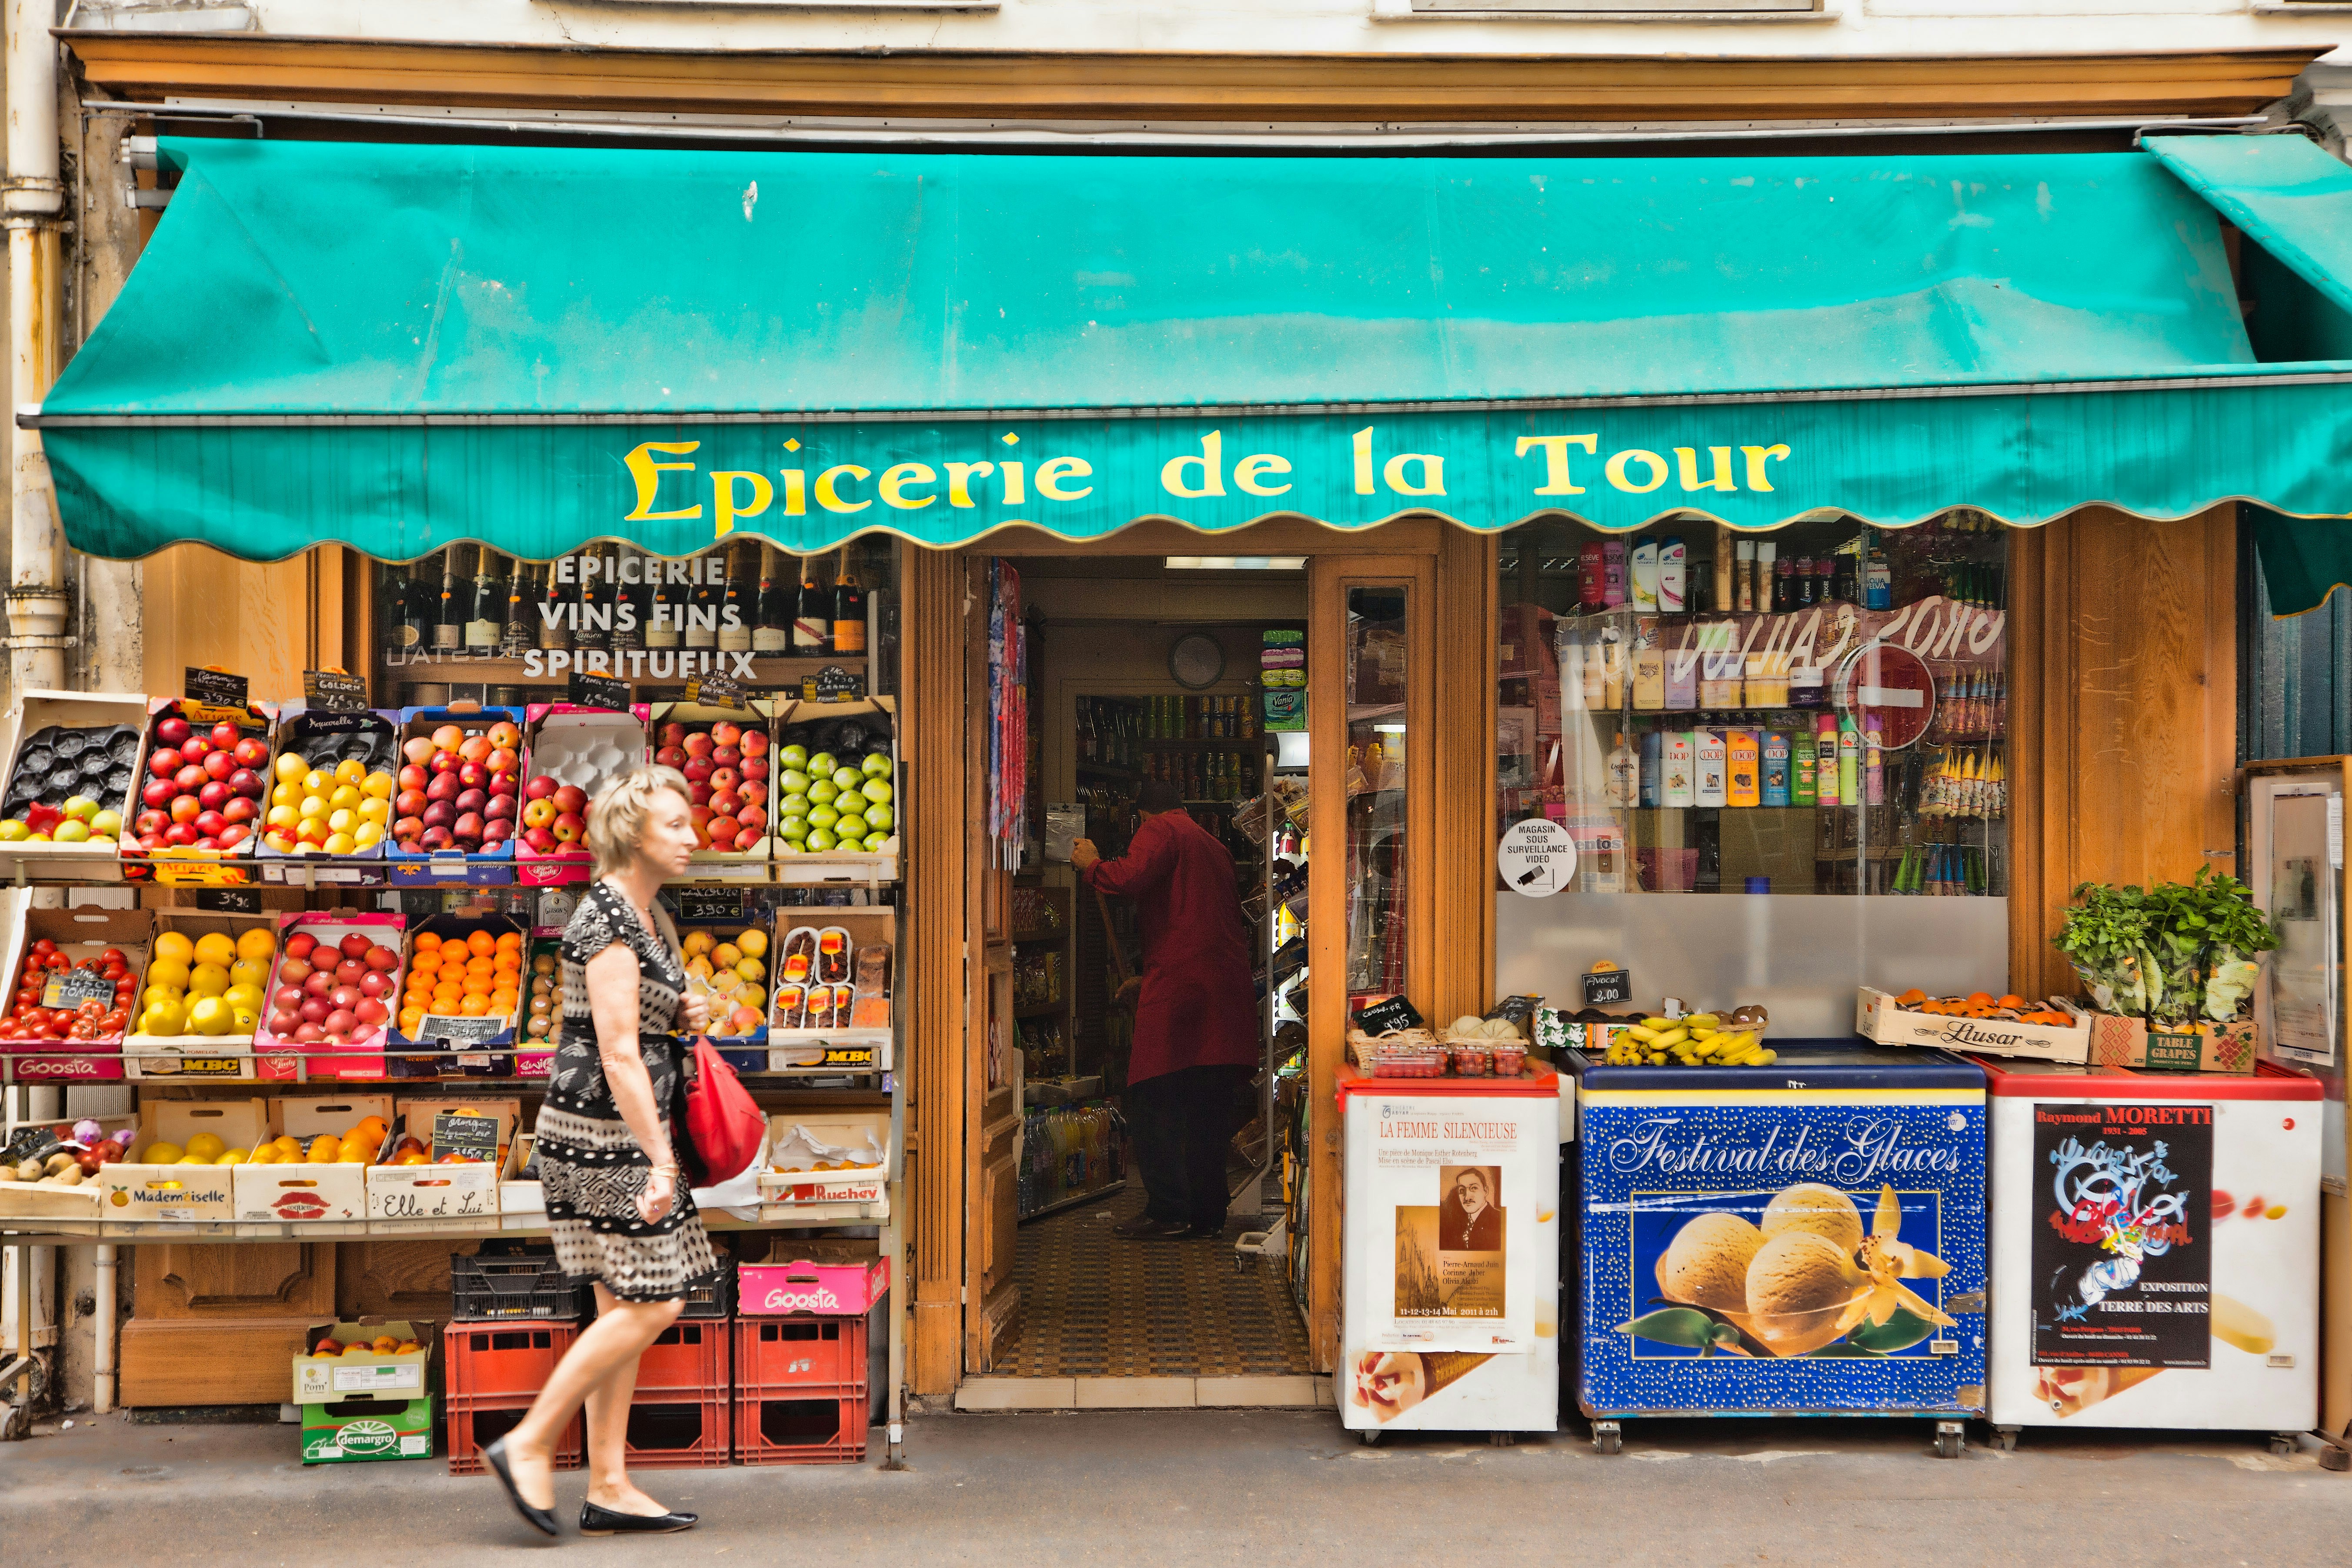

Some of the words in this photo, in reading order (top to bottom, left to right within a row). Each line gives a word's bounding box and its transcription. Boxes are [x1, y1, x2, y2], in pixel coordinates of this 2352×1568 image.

[624, 432, 1094, 539] Epicerie
[1160, 434, 1292, 498] de
[1355, 426, 1447, 498] la
[1515, 434, 1791, 496] Tour
[557, 556, 724, 585] EPICERIE
[537, 603, 636, 631] VINS
[653, 604, 742, 632] FINS
[523, 649, 757, 679] SPIRITUEUX
[319, 680, 360, 691] GOLDEN
[193, 711, 242, 721] Ariane
[1702, 751, 1722, 760] DOP
[1735, 751, 1755, 760] DOP
[1768, 750, 1788, 758] DOP
[1552, 815, 1616, 826] mentos
[1519, 825, 1556, 834] MAGASIN
[1508, 845, 1568, 854] SURVEILLANCE
[1571, 837, 1622, 851] entos
[1525, 855, 1550, 864] VIDEO
[1587, 976, 1620, 987] Avocat
[1593, 989, 1619, 1002] 2.00
[1941, 1021, 2023, 1048] Llusar
[2157, 1037, 2194, 1048] TABLE
[2152, 1048, 2197, 1060] GRAPES
[18, 1058, 97, 1075] Goosta
[183, 1059, 238, 1071] MBC
[2036, 1111, 2101, 1125] Raymond
[2105, 1107, 2212, 1124] MORETTI
[1380, 1122, 1394, 1138] LA
[1397, 1122, 1438, 1139] FEMME
[1444, 1122, 1518, 1139] SILENCIEUSE
[1390, 1149, 1403, 1158] pièce
[1411, 1150, 1434, 1158] Monique
[1452, 1150, 1478, 1159] Rotenberg
[1611, 1117, 1781, 1173] Festival
[1778, 1125, 1831, 1171] des
[1835, 1115, 1962, 1184] Glaces
[286, 1204, 315, 1212] coquette
[384, 1194, 424, 1217] Elle
[432, 1196, 447, 1215] et
[457, 1191, 483, 1214] Lui
[870, 1266, 886, 1301] Goosta
[2140, 1282, 2209, 1293] EXPOSITION
[764, 1287, 840, 1310] Goosta
[1400, 1308, 1441, 1317] 11-12-13-14
[1442, 1307, 1457, 1315] Mai
[1479, 1308, 1484, 1316] à
[1485, 1308, 1498, 1316] 21h
[2099, 1301, 2144, 1313] TERRE
[2145, 1301, 2172, 1313] DES
[2174, 1302, 2209, 1314] ARTS
[340, 1435, 392, 1447] demargro
